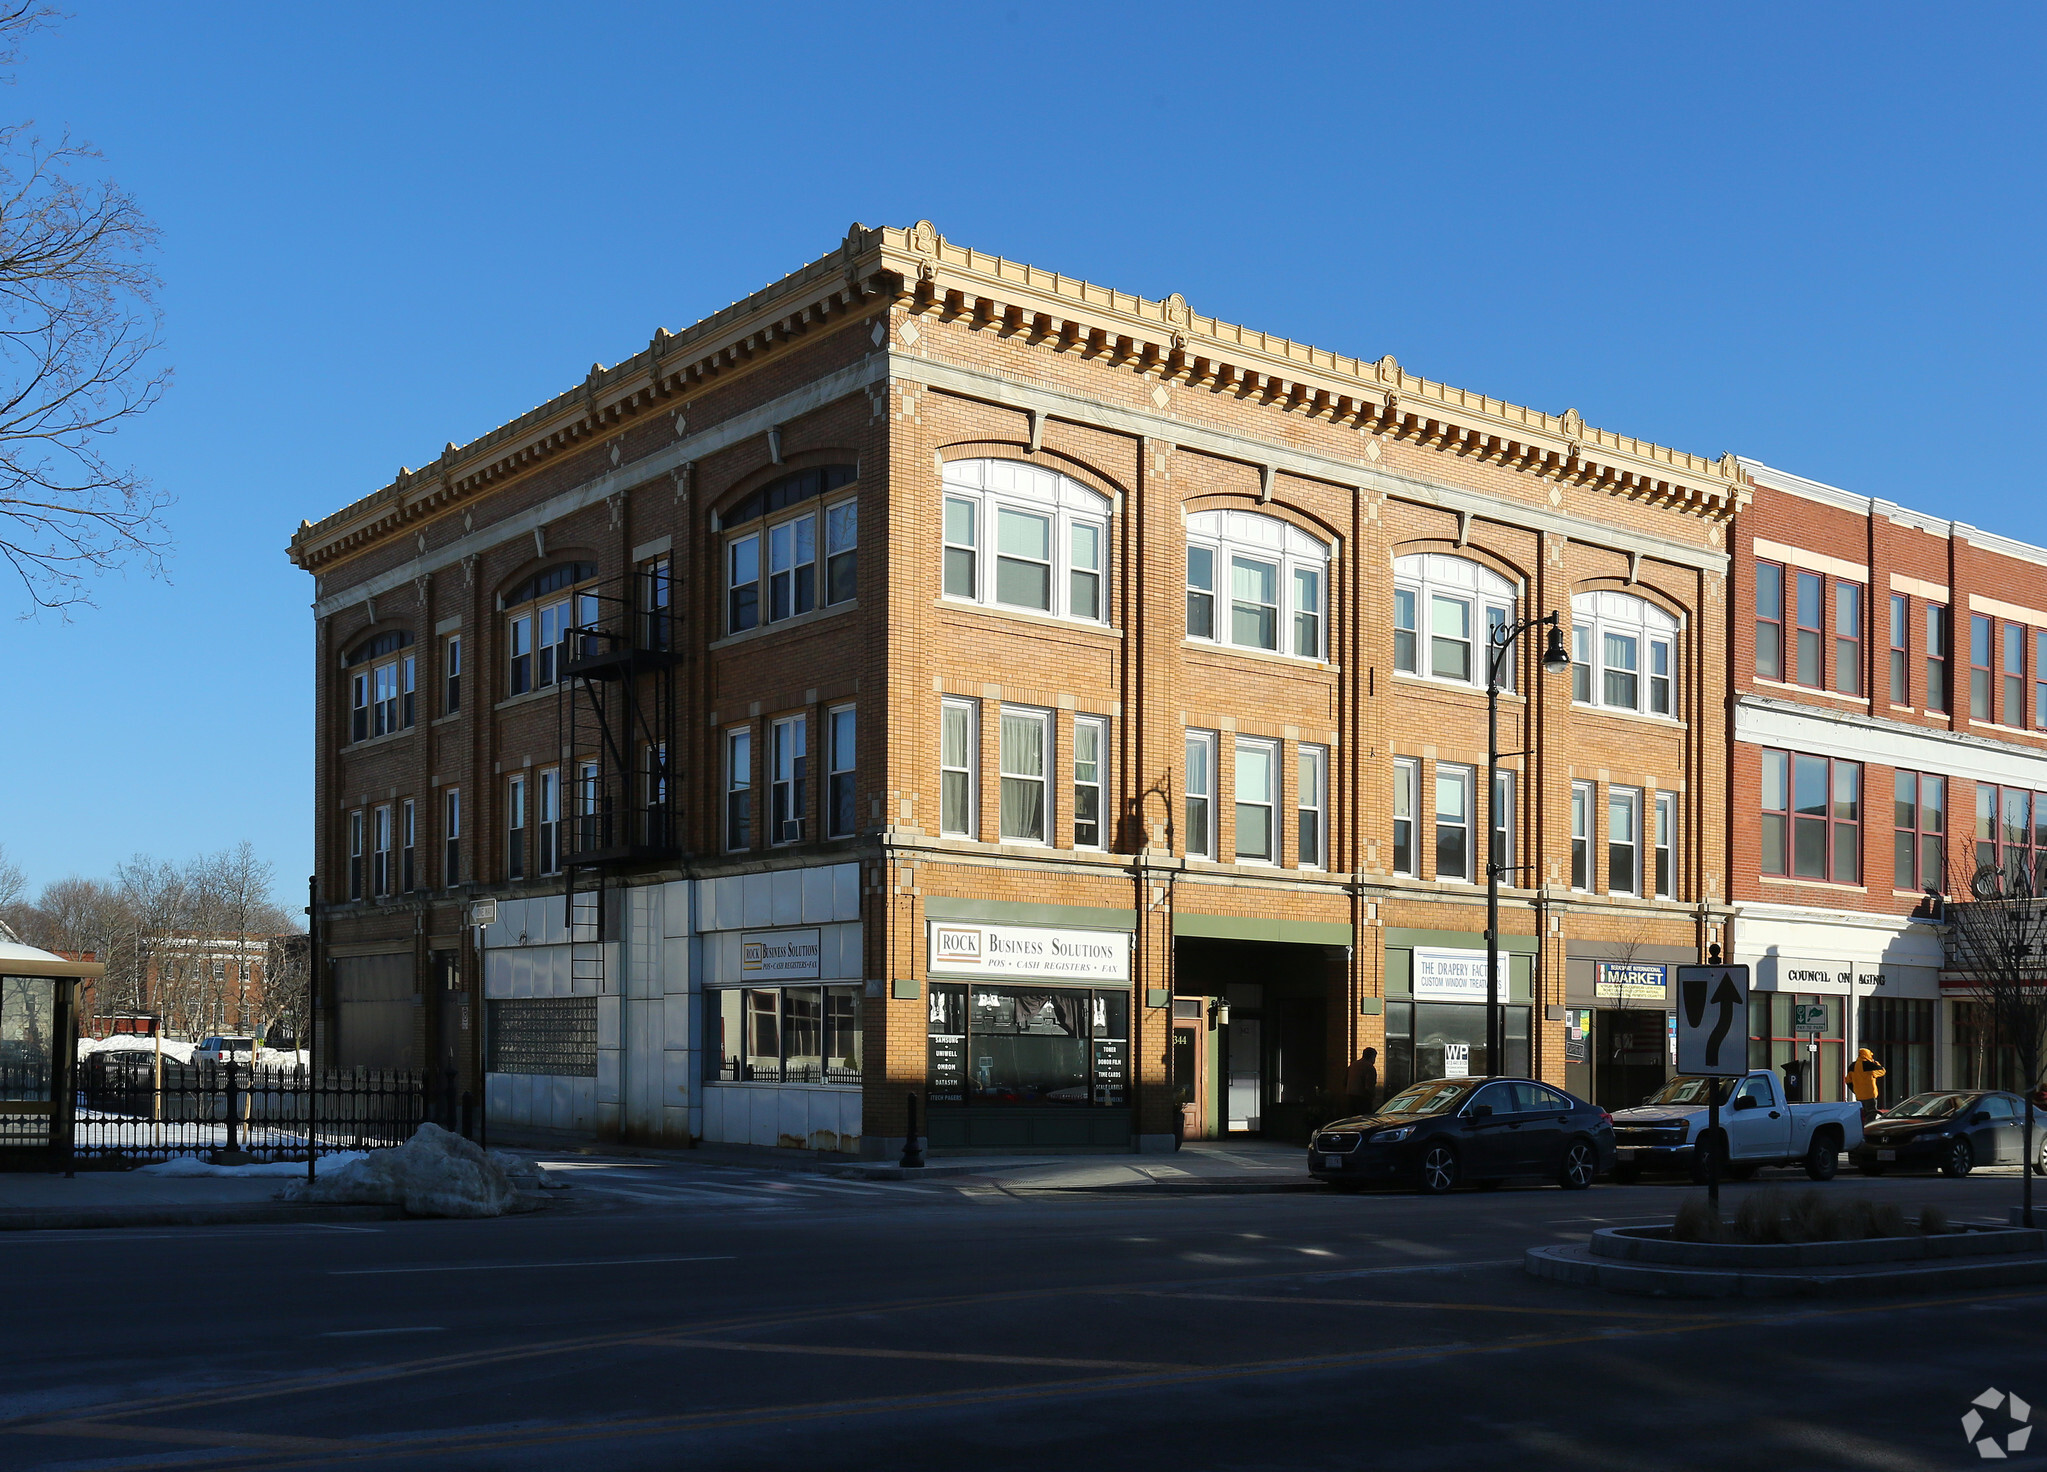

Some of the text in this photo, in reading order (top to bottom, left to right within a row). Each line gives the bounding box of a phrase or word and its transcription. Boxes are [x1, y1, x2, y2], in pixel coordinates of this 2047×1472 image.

[943, 934, 976, 951] ROCK
[989, 933, 1113, 959] BUSINESS SOLUTIONS
[746, 948, 760, 959] ROCK
[784, 961, 807, 969] REGISTERS
[988, 959, 1005, 967] POS
[1016, 960, 1040, 969] CASH
[1044, 962, 1091, 971] REGISTERS
[1421, 961, 1502, 978] THE DRAPERY FACTY
[1421, 976, 1444, 987] CUSTOM
[1445, 977, 1468, 988] WINDOW
[1608, 970, 1664, 985] MARKET
[1788, 969, 1886, 986] COUNCIL ON AGING
[1174, 1035, 1187, 1044] 344
[1445, 1044, 1468, 1060] WP
